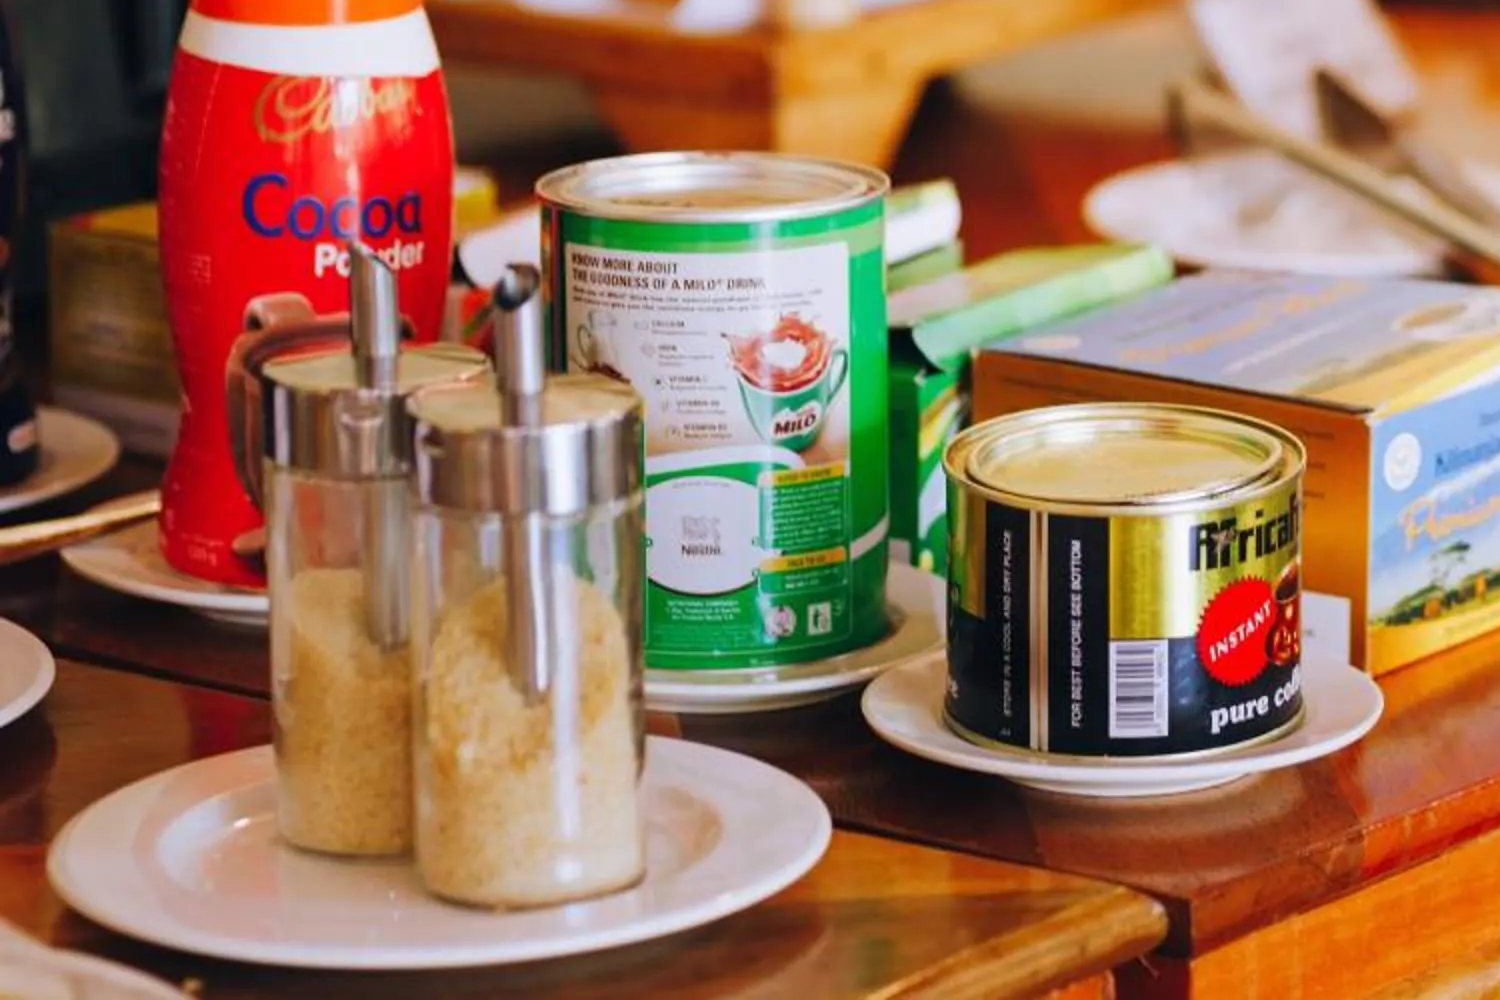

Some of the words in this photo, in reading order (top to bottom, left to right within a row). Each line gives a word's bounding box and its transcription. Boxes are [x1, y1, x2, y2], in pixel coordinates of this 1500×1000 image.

[242, 173, 421, 240] Cocoa
[315, 241, 424, 278] Poder
[572, 254, 599, 268] KNOW
[602, 258, 631, 272] MORE
[638, 261, 679, 274] ABOUT
[590, 272, 649, 289] GOODNESS
[653, 278, 666, 289] OF
[671, 278, 680, 289] A
[774, 413, 816, 435] MILO
[1003, 530, 1012, 568] PLACE
[1071, 540, 1082, 591] BOTTOM
[1003, 570, 1012, 593] DRY
[1003, 595, 1012, 618] AND
[1071, 594, 1082, 617] SEE
[1003, 622, 1012, 652] COOL
[1071, 620, 1082, 667] BEFORE
[1210, 599, 1271, 663] INSTANT
[1003, 679, 1012, 717] STORE
[1071, 670, 1082, 700] BEST
[1071, 702, 1082, 728] FOR
[1210, 695, 1269, 735] pure
